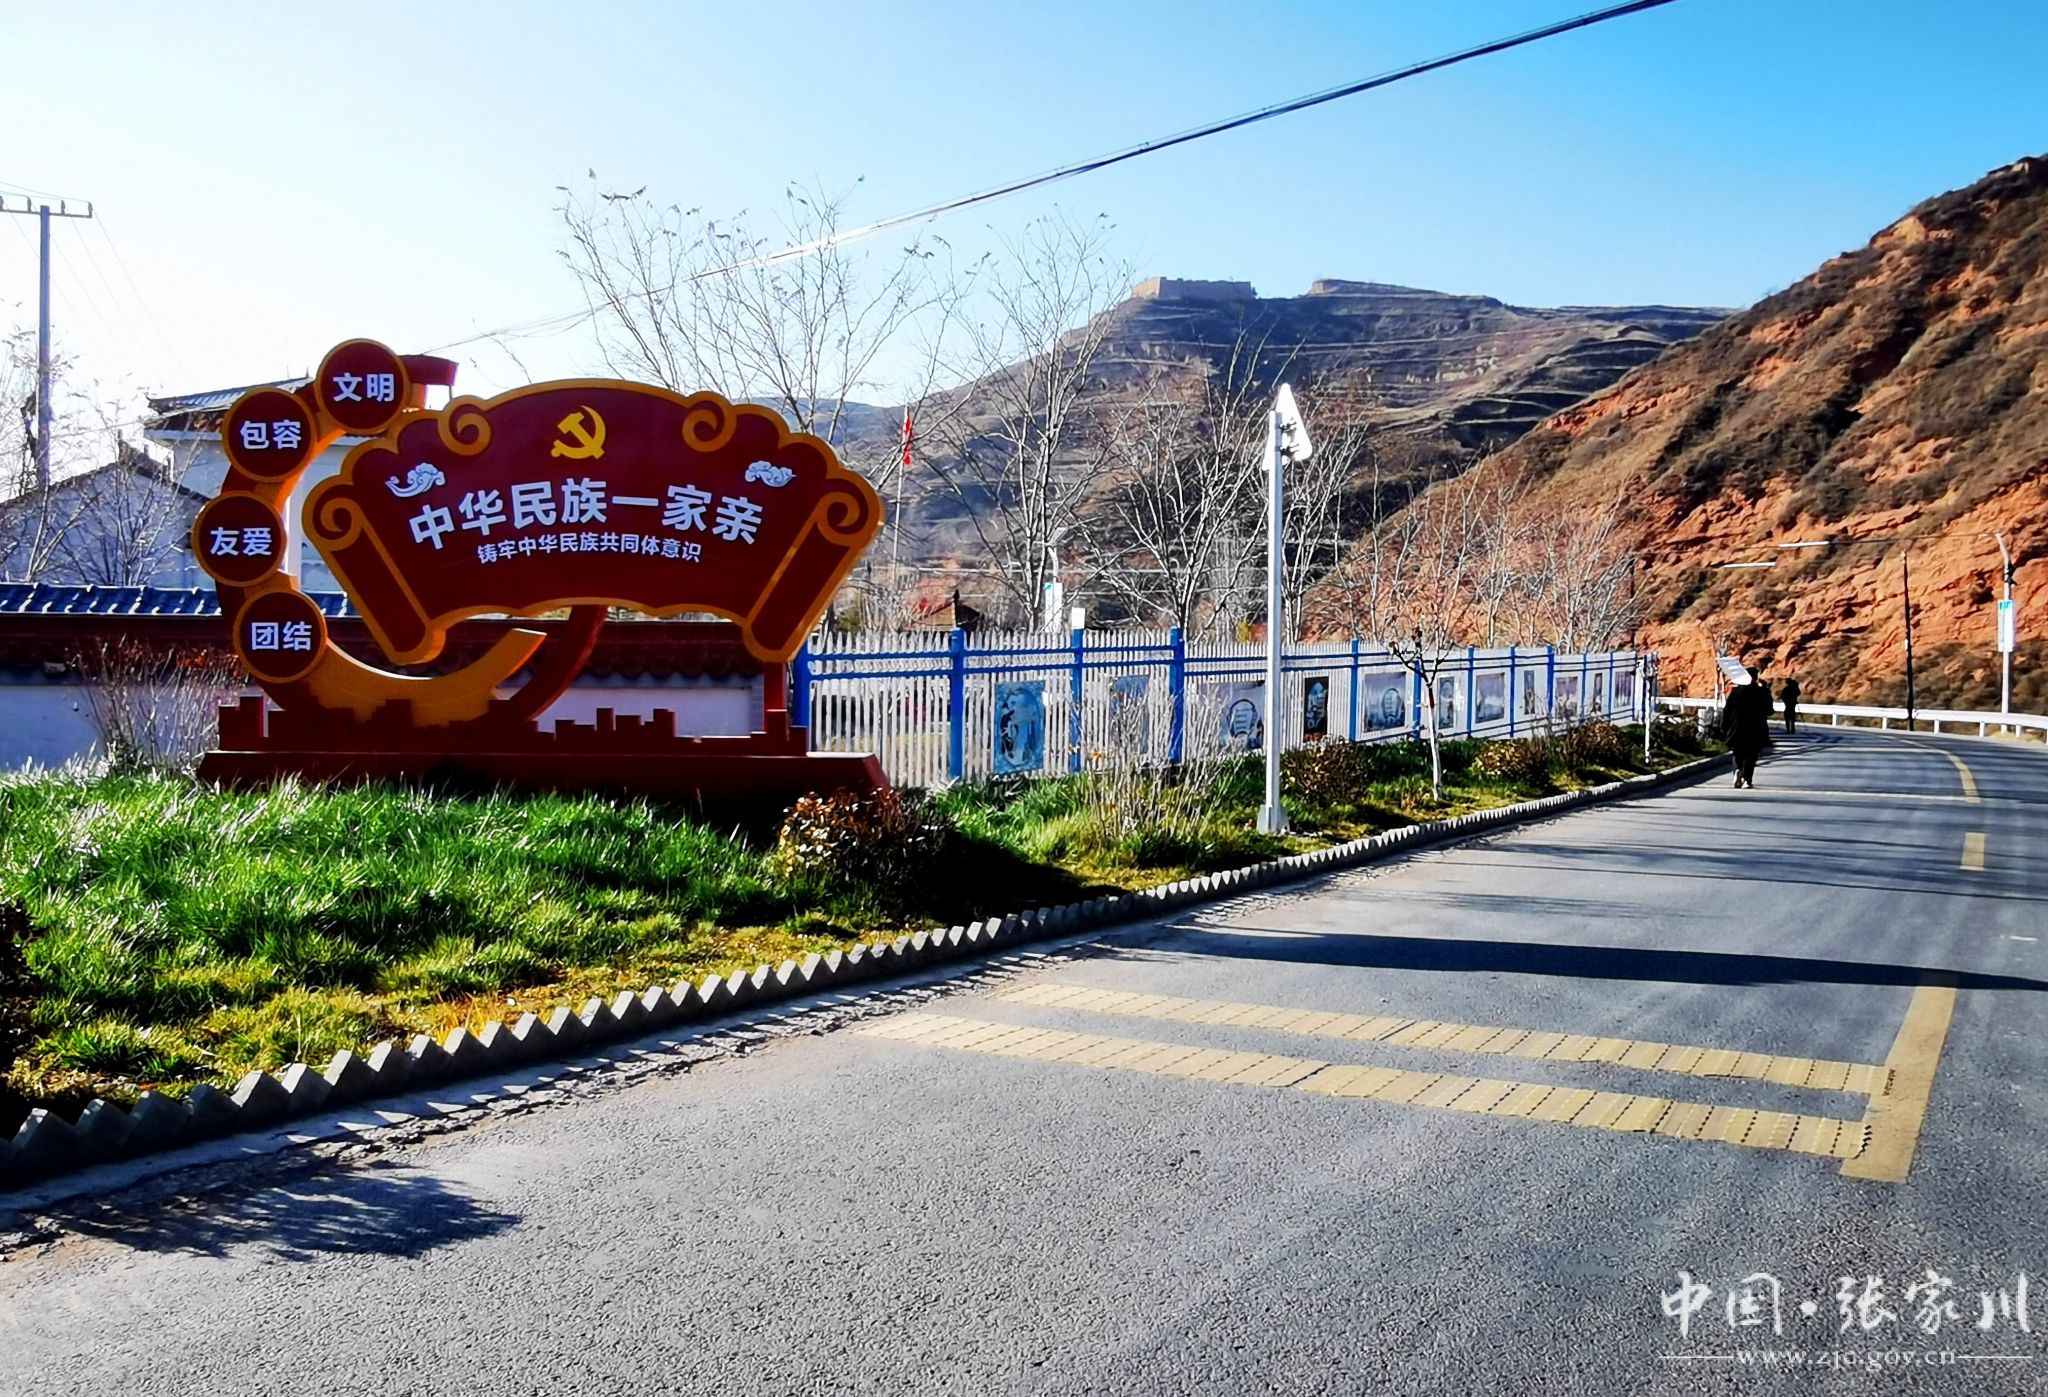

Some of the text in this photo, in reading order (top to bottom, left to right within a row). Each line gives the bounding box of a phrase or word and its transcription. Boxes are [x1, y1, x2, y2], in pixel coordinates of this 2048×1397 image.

[333, 371, 395, 402] 文明
[240, 418, 302, 450] 包容
[409, 477, 763, 550] 中华民族一家亲
[210, 525, 272, 556] 友爱
[477, 532, 702, 564] 铸牢中华民族共同体意识
[251, 620, 312, 651] 团结
